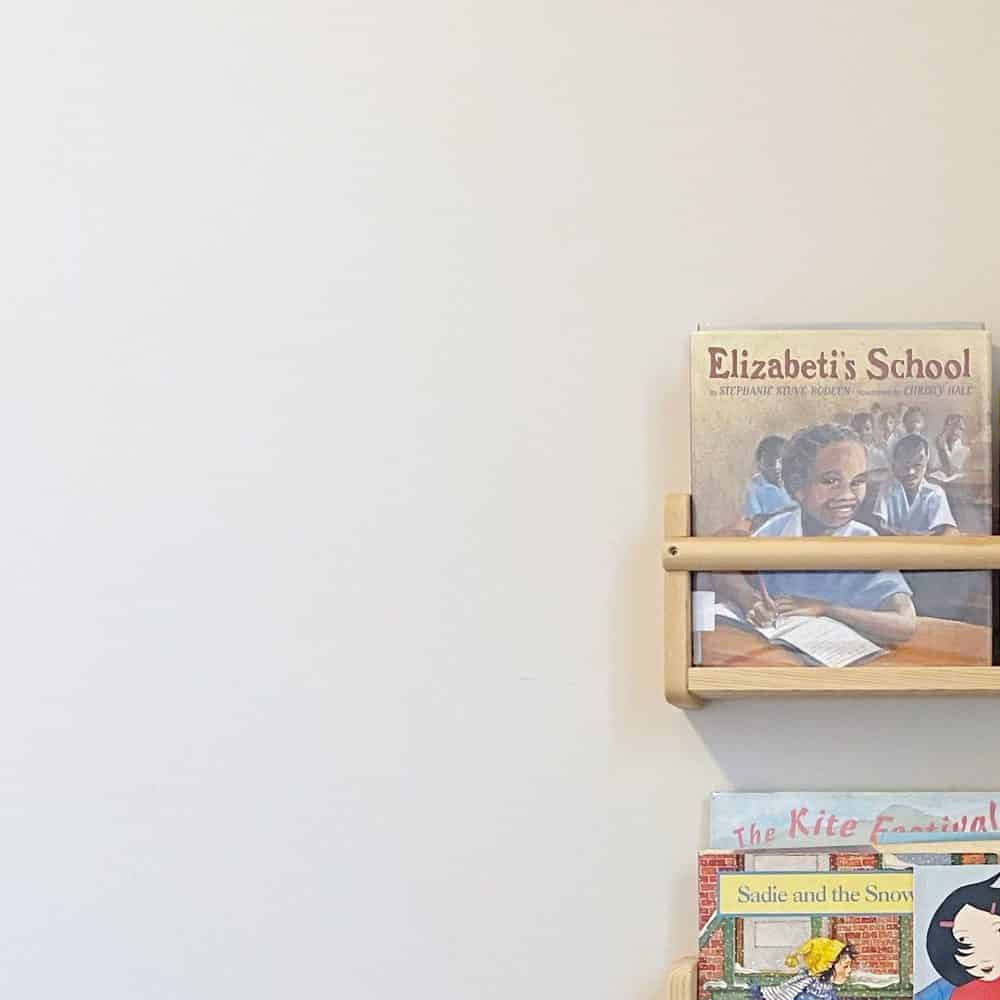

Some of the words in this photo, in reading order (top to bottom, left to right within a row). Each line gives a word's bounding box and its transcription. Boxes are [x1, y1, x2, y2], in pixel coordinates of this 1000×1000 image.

[708, 346, 857, 380] Elizabeti's
[866, 347, 970, 380] School
[733, 823, 776, 848] The
[788, 807, 857, 838] Kite
[738, 885, 787, 903] Sadie
[793, 885, 826, 903] and
[832, 885, 861, 903] the
